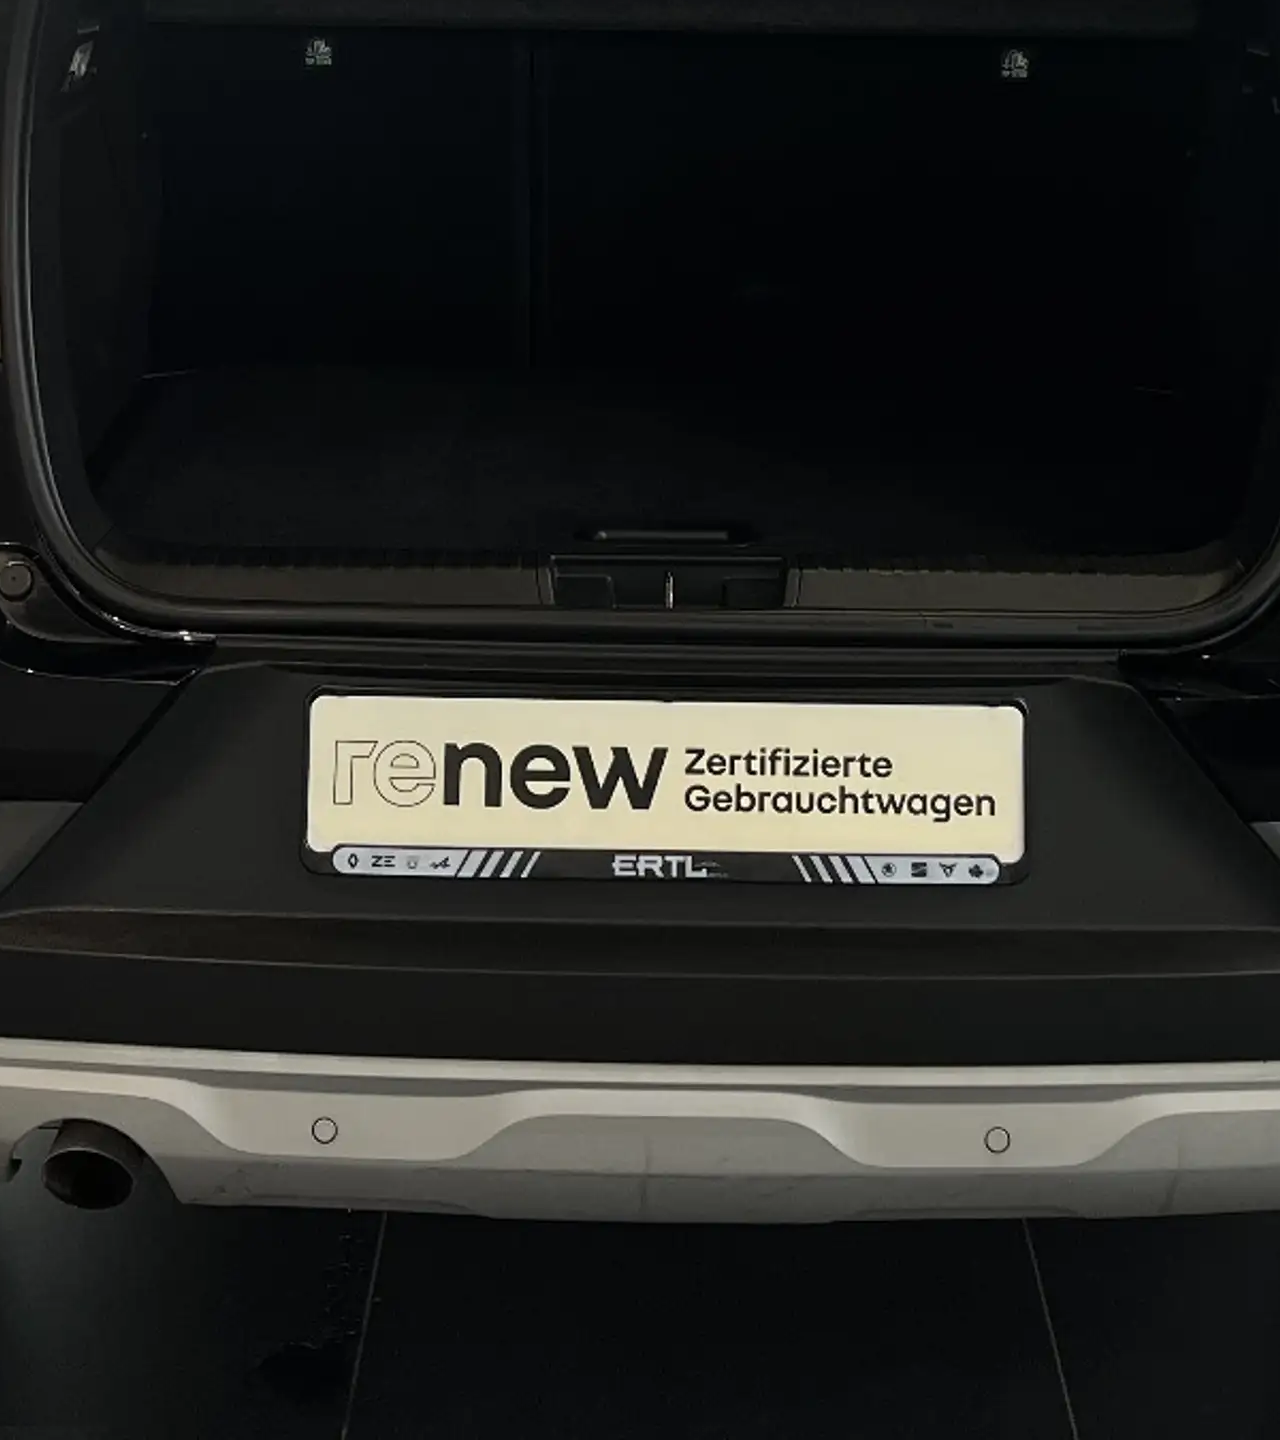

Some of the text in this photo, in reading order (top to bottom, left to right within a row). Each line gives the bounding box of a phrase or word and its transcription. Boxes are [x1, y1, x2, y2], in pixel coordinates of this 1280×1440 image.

[332, 739, 669, 810] renew
[684, 747, 894, 779] Zertifizierte
[684, 783, 997, 823] Gebrauchtwagen
[611, 854, 708, 879] ERTL
